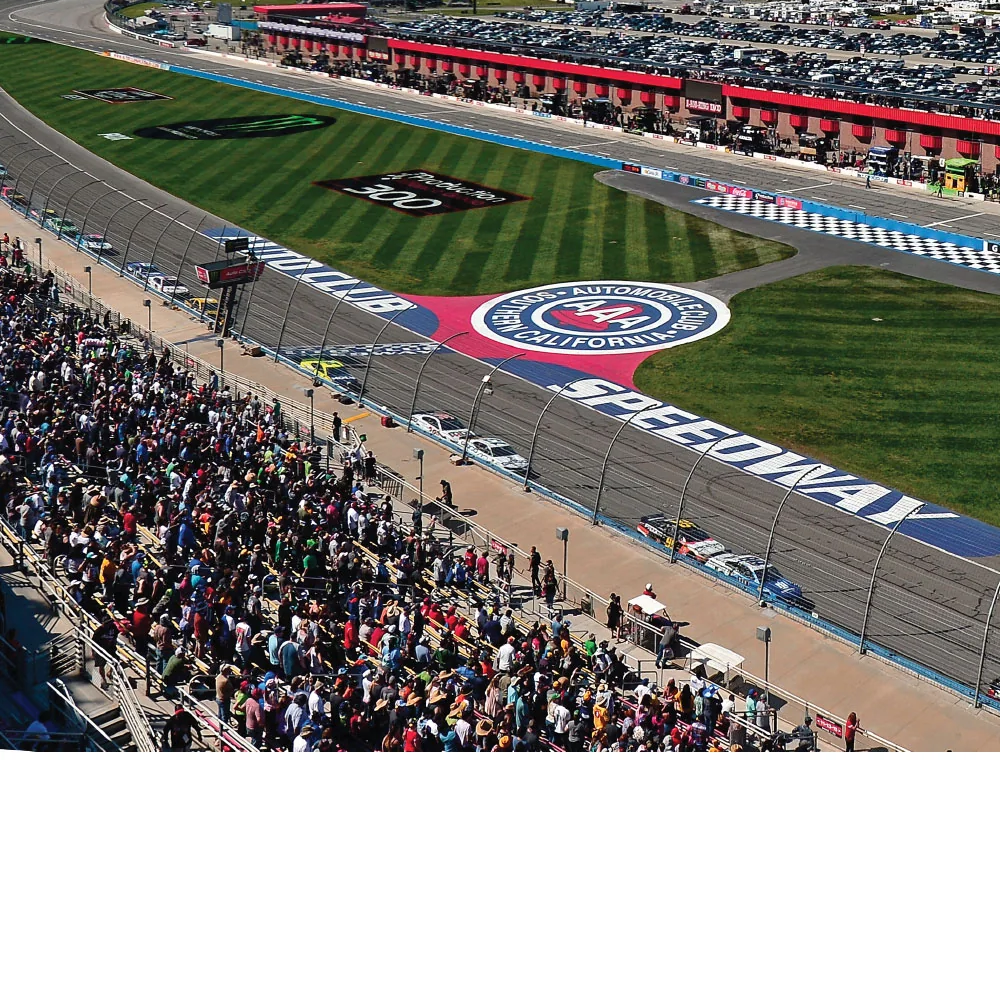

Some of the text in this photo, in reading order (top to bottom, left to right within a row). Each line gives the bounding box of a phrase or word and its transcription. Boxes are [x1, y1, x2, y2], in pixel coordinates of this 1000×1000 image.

[342, 184, 442, 209] 300
[212, 237, 418, 313] AUTO CLUB
[492, 291, 675, 348] SOUTHERN CALIFORNIA
[563, 300, 651, 330] AAA
[572, 286, 710, 332] AUTOMOBILE CLUB
[547, 378, 958, 524] SPEEDWAY
